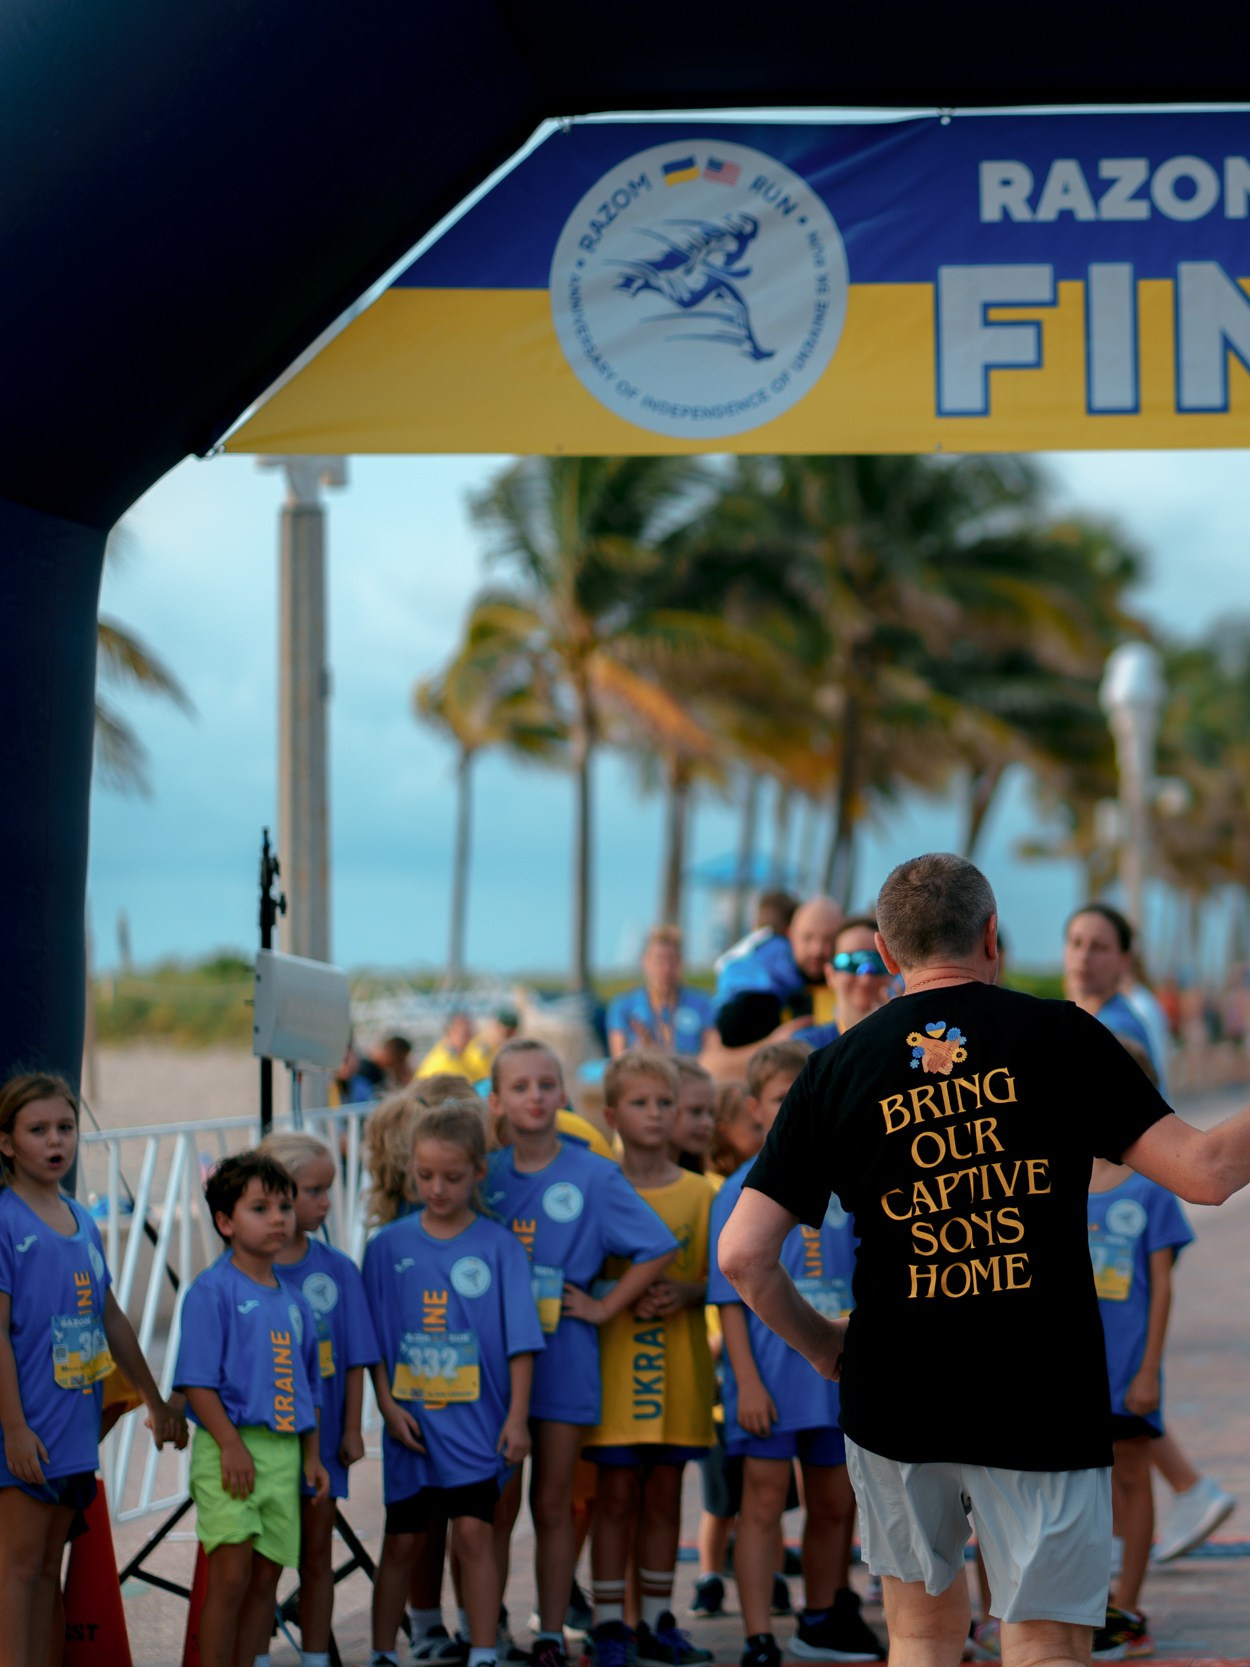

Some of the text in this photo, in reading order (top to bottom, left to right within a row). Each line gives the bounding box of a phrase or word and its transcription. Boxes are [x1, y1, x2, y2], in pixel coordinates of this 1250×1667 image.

[578, 172, 798, 253] RAZOM RUN
[568, 271, 618, 383] ANNIVERSARY
[615, 379, 639, 401] OF
[640, 387, 771, 421] INDEPENDENCE
[878, 1067, 1018, 1135] BRING
[911, 1117, 1005, 1168] OUR
[881, 1159, 1051, 1220] CAPTIVE
[911, 1207, 1025, 1256] SONS
[908, 1253, 1032, 1299] HOME
[270, 1330, 295, 1432] KRAINE
[407, 1346, 459, 1379] 332
[632, 1316, 666, 1420] UKRA
